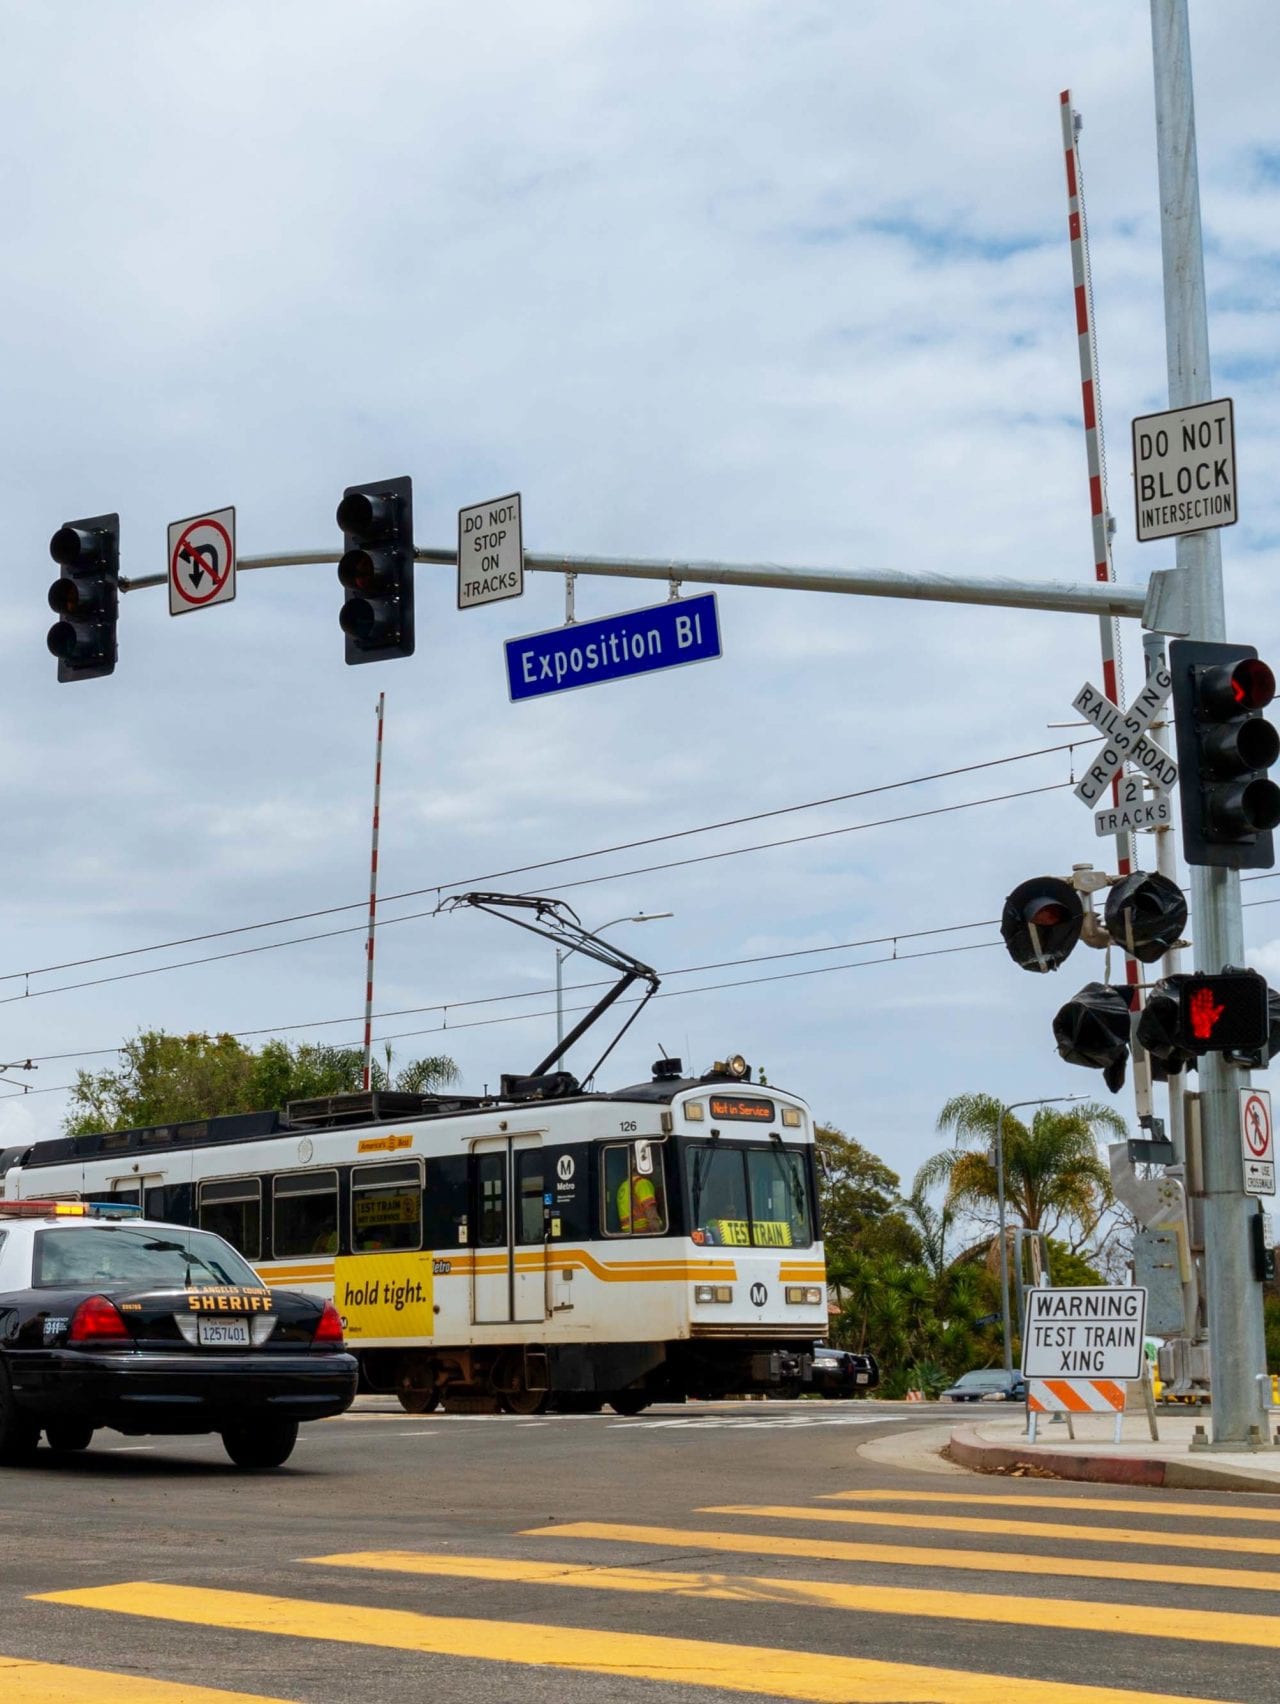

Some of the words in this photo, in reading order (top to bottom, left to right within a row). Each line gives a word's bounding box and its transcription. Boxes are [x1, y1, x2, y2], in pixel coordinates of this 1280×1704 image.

[1140, 430, 1168, 461] DO
[1182, 417, 1226, 452] NOT
[1140, 458, 1230, 502] BLOCK
[464, 515, 483, 533] DO
[489, 505, 514, 527] NOT
[1141, 493, 1232, 529] INTERSECTION
[473, 530, 507, 553] STOP
[481, 554, 500, 572] ON
[464, 571, 517, 598] TRACKS
[521, 629, 662, 685] Exposition
[674, 613, 703, 649] Bl
[1080, 671, 1171, 800] CROSSING
[1124, 782, 1137, 802] 2
[1097, 803, 1168, 831] TRACKS
[712, 1101, 728, 1114] Not
[729, 1104, 738, 1114] in
[738, 1103, 770, 1118] Service
[619, 1120, 637, 1132] 126
[556, 1183, 575, 1191] Metro
[377, 1199, 401, 1211] TRAIN
[753, 1223, 784, 1245] TRAIN
[203, 1286, 239, 1294] ANGELES
[242, 1287, 272, 1296] COUNTY
[344, 1280, 379, 1306] hold
[383, 1277, 427, 1311] tight.
[187, 1295, 273, 1311] SHERIFF
[1037, 1295, 1137, 1317] WARNING
[203, 1327, 246, 1341] 1257401
[1034, 1326, 1076, 1347] TEST
[1084, 1326, 1136, 1347] TRAIN
[1060, 1350, 1105, 1372] XING
